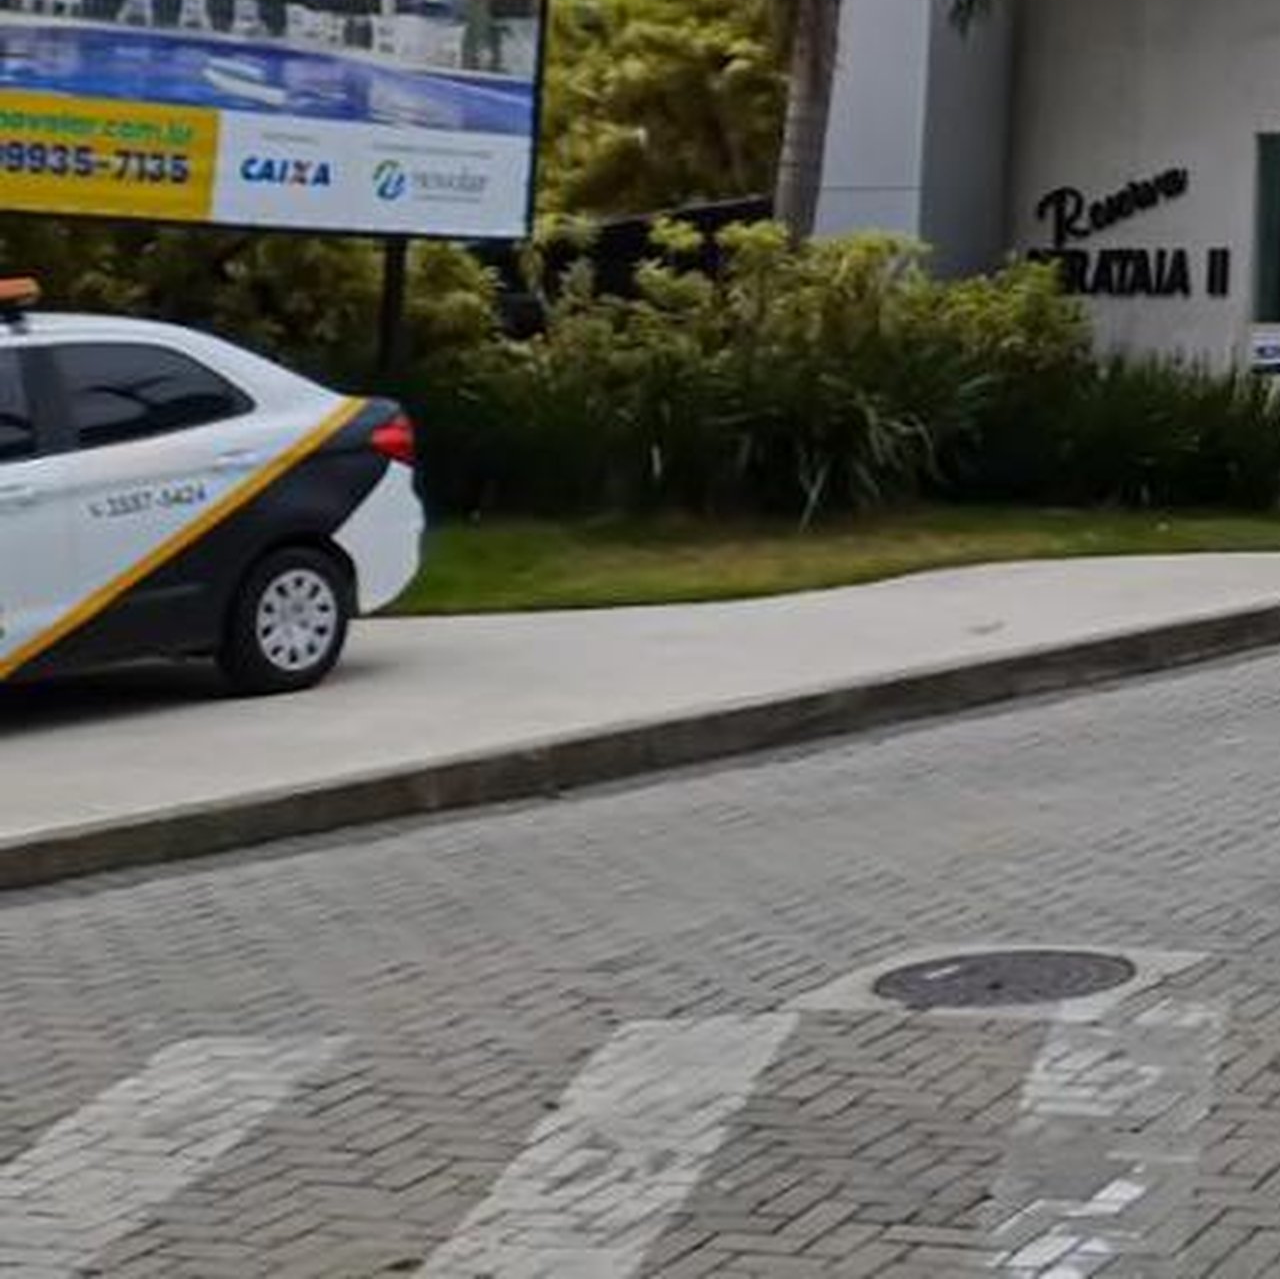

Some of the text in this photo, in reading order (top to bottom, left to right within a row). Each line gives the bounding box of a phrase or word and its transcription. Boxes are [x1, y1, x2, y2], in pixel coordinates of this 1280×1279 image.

[0, 140, 190, 184] 9935-7135
[240, 158, 331, 187] CAIXA
[1027, 247, 1191, 297] RATAIA
